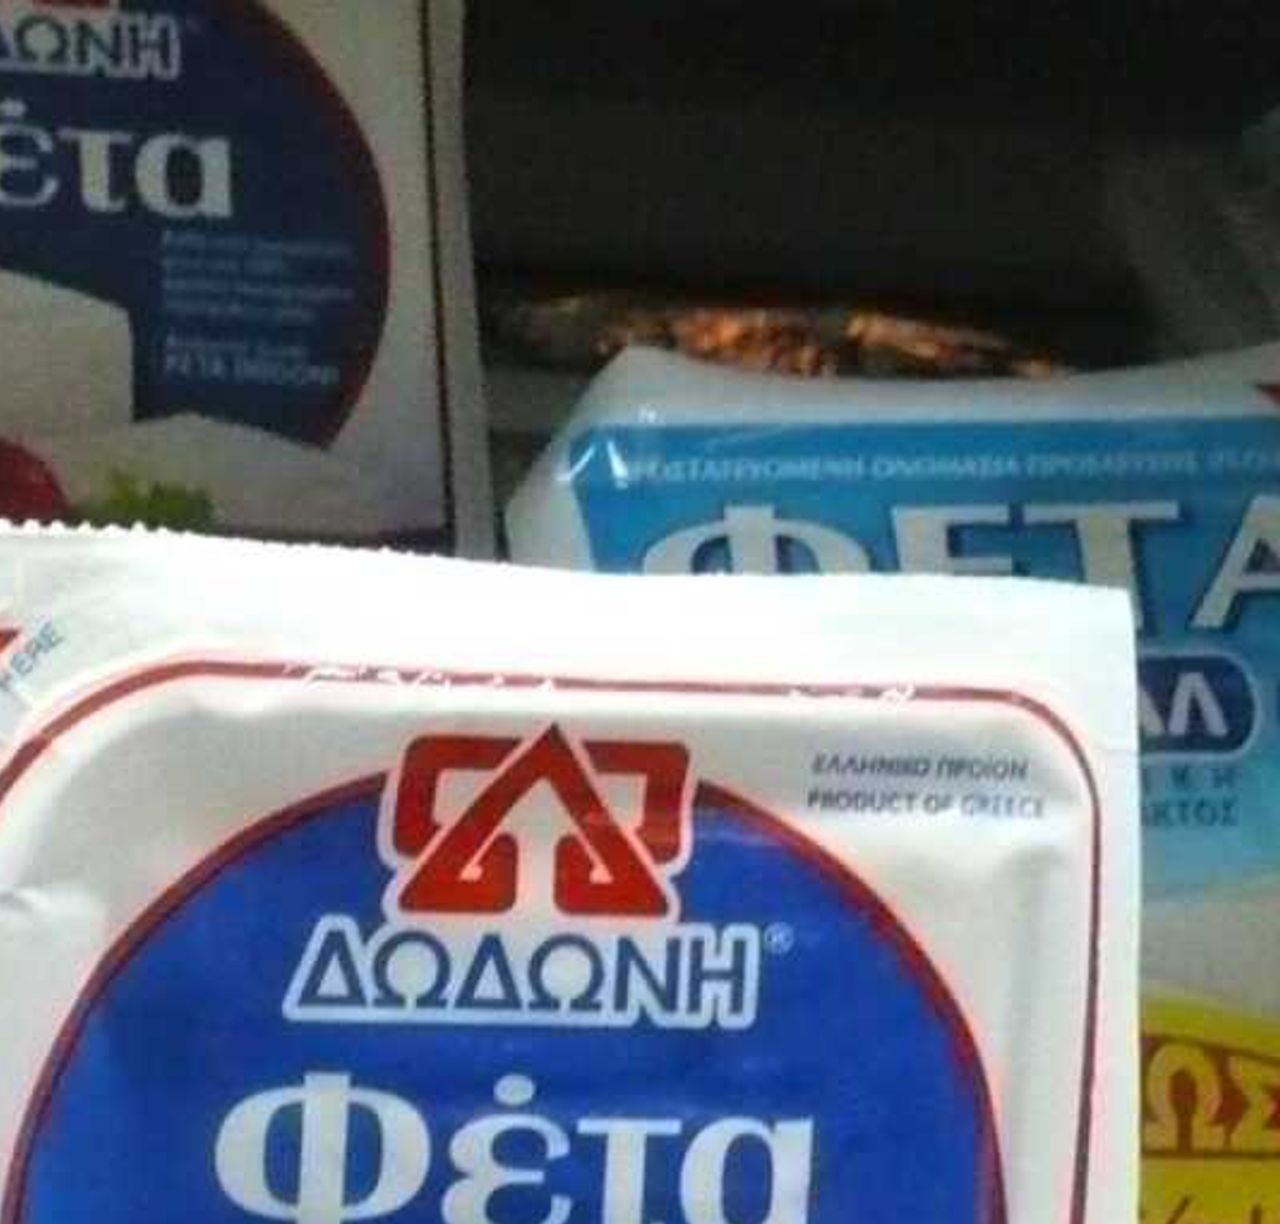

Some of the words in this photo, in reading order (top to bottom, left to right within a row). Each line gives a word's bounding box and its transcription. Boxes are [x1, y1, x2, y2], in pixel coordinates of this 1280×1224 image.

[806, 786, 916, 815] PRODUCT
[922, 791, 954, 816] OF
[960, 795, 1045, 819] GREECE
[292, 906, 748, 1022] ΔΩΔΩΝΗ
